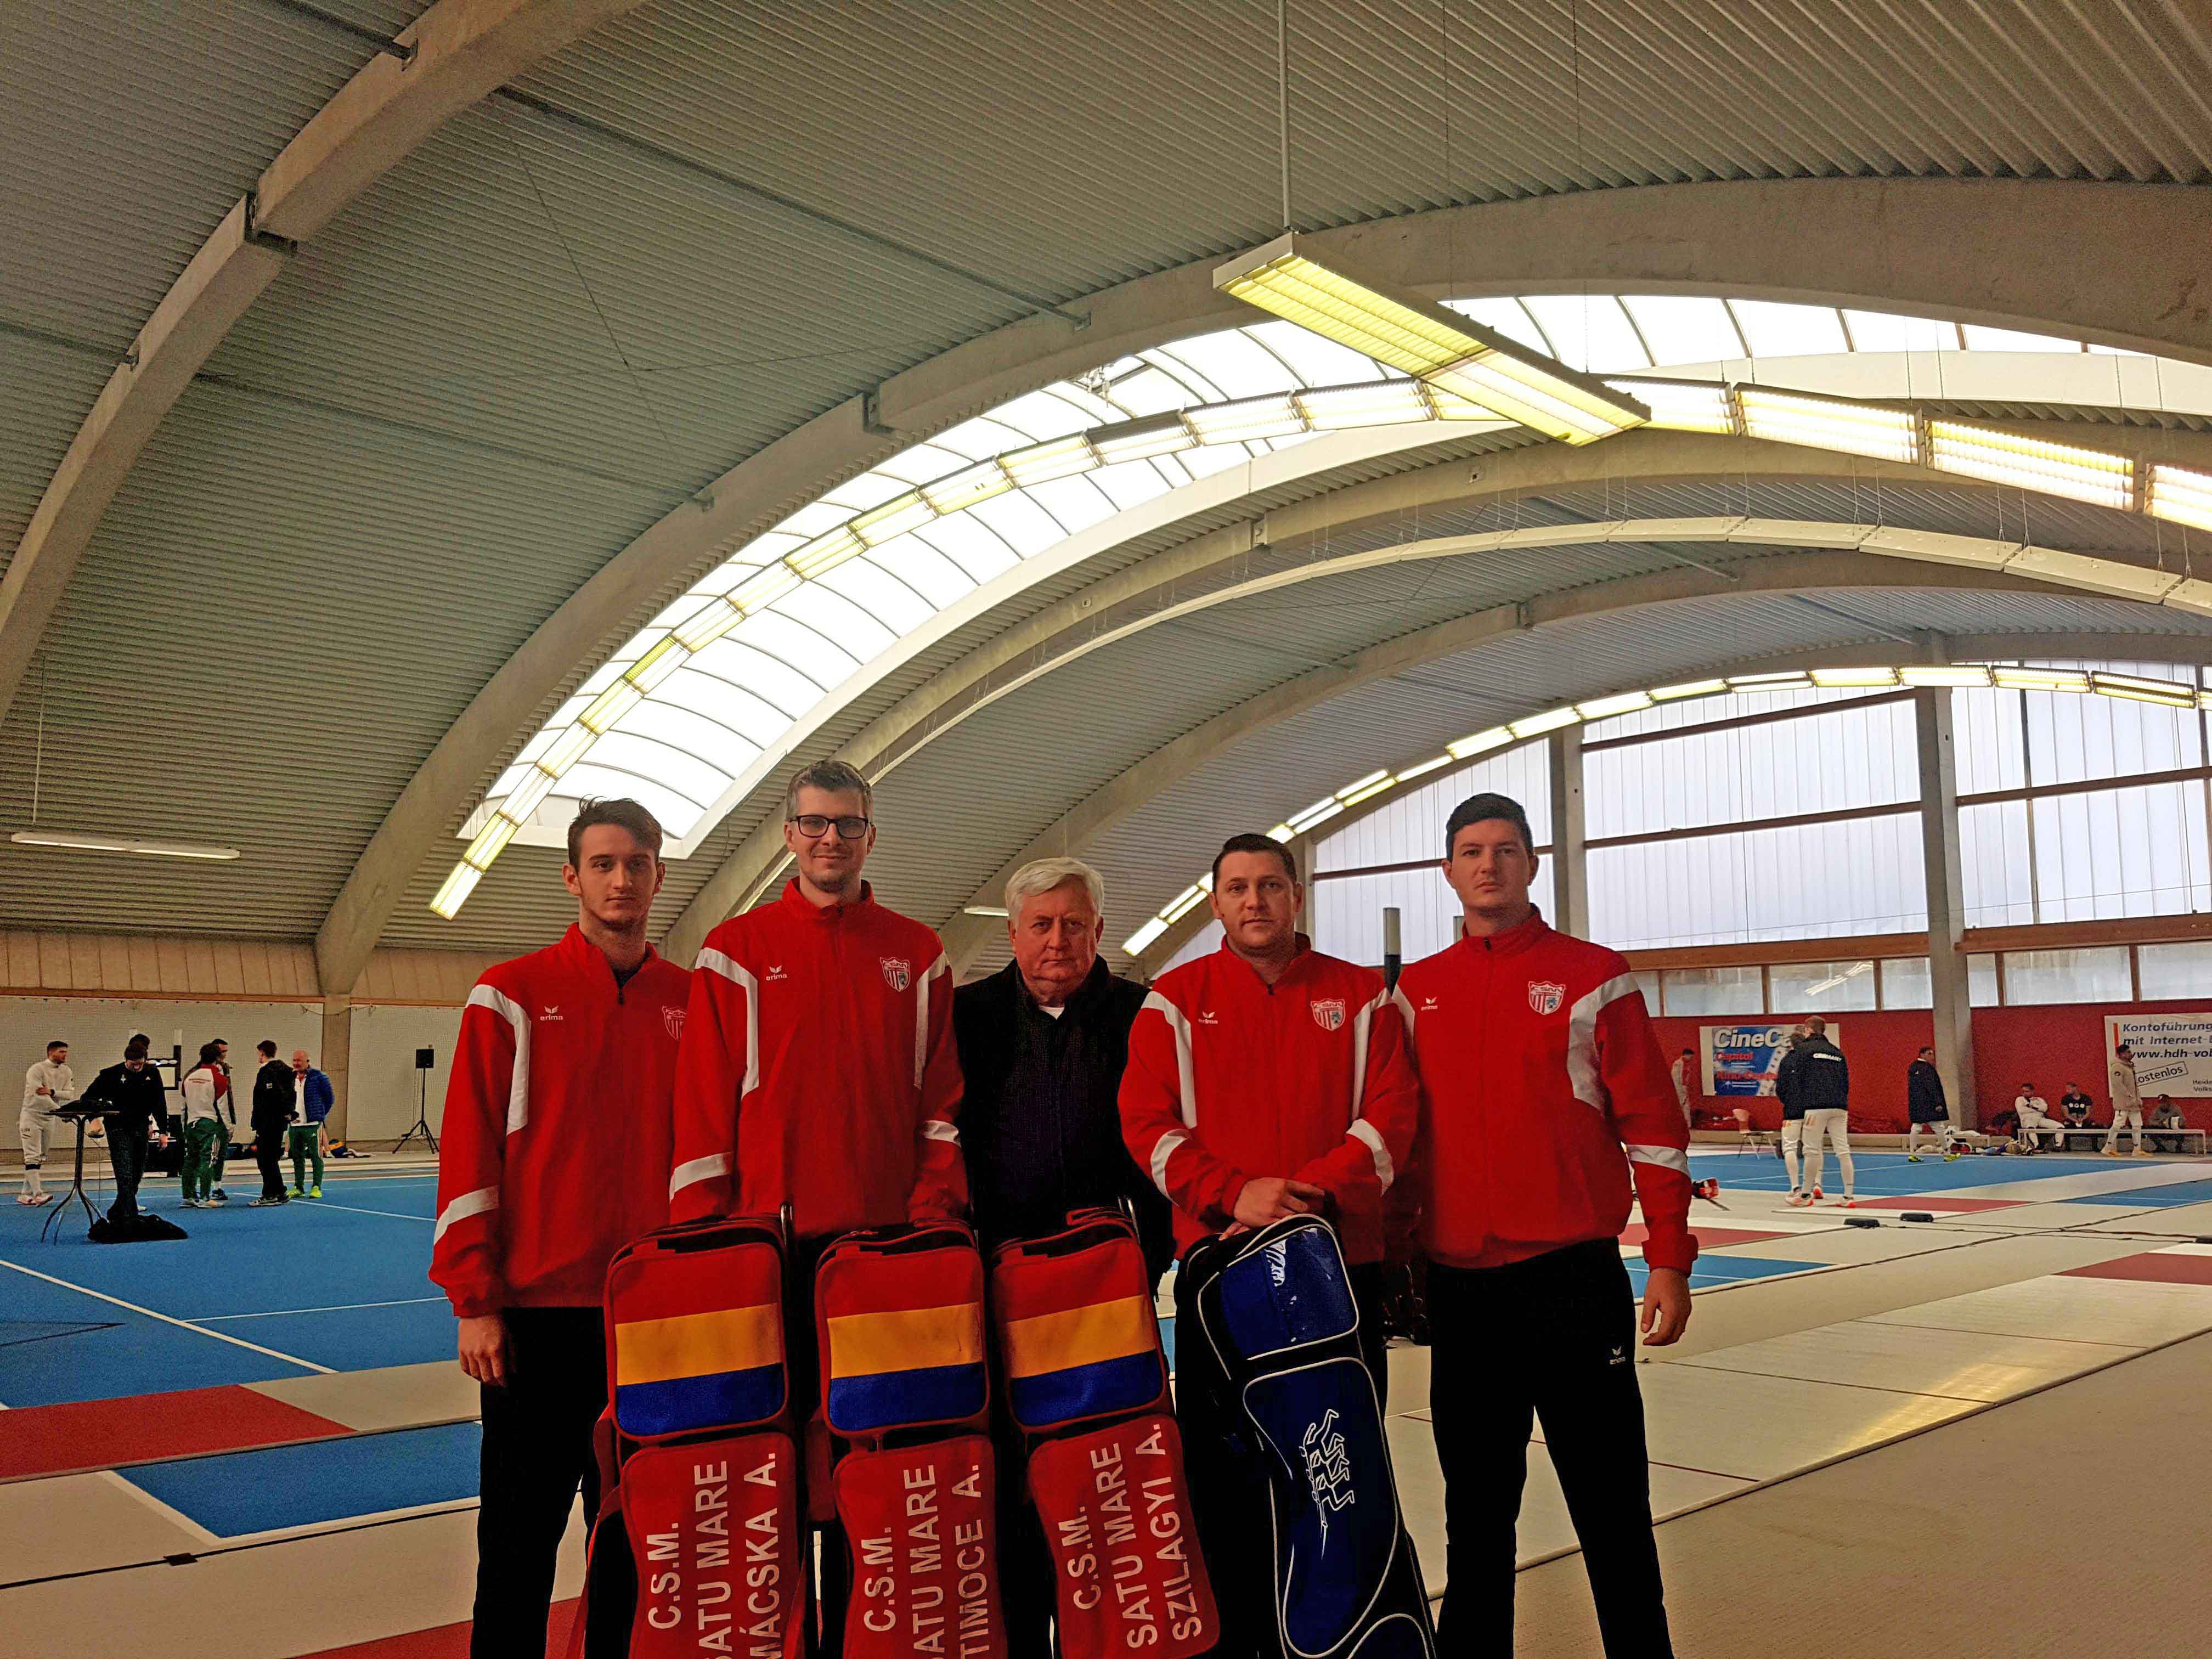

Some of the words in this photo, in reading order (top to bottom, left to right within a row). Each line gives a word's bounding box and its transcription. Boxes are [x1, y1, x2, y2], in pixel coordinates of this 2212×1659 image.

[2123, 1022, 2212, 1032] Kontoführung
[2124, 1036, 2144, 1045] mit
[2131, 1048, 2212, 1058] ww.hdh-vol
[2137, 1066, 2183, 1084] ostenlos
[743, 1453, 776, 1487] A.
[1135, 1424, 1166, 1455] A.
[694, 1460, 730, 1568] MARE
[903, 1465, 941, 1573] MARE
[952, 1465, 981, 1498] A.
[1090, 1443, 1137, 1545] MARE
[646, 1522, 681, 1629] C.S.M.
[861, 1527, 896, 1632] C.S.M.
[1058, 1506, 1101, 1610] C.S.M.
[1142, 1476, 1202, 1640] SZILAGYI
[697, 1581, 732, 1659] ATU
[911, 1586, 945, 1659] ATU
[1112, 1555, 1158, 1648] SATU
